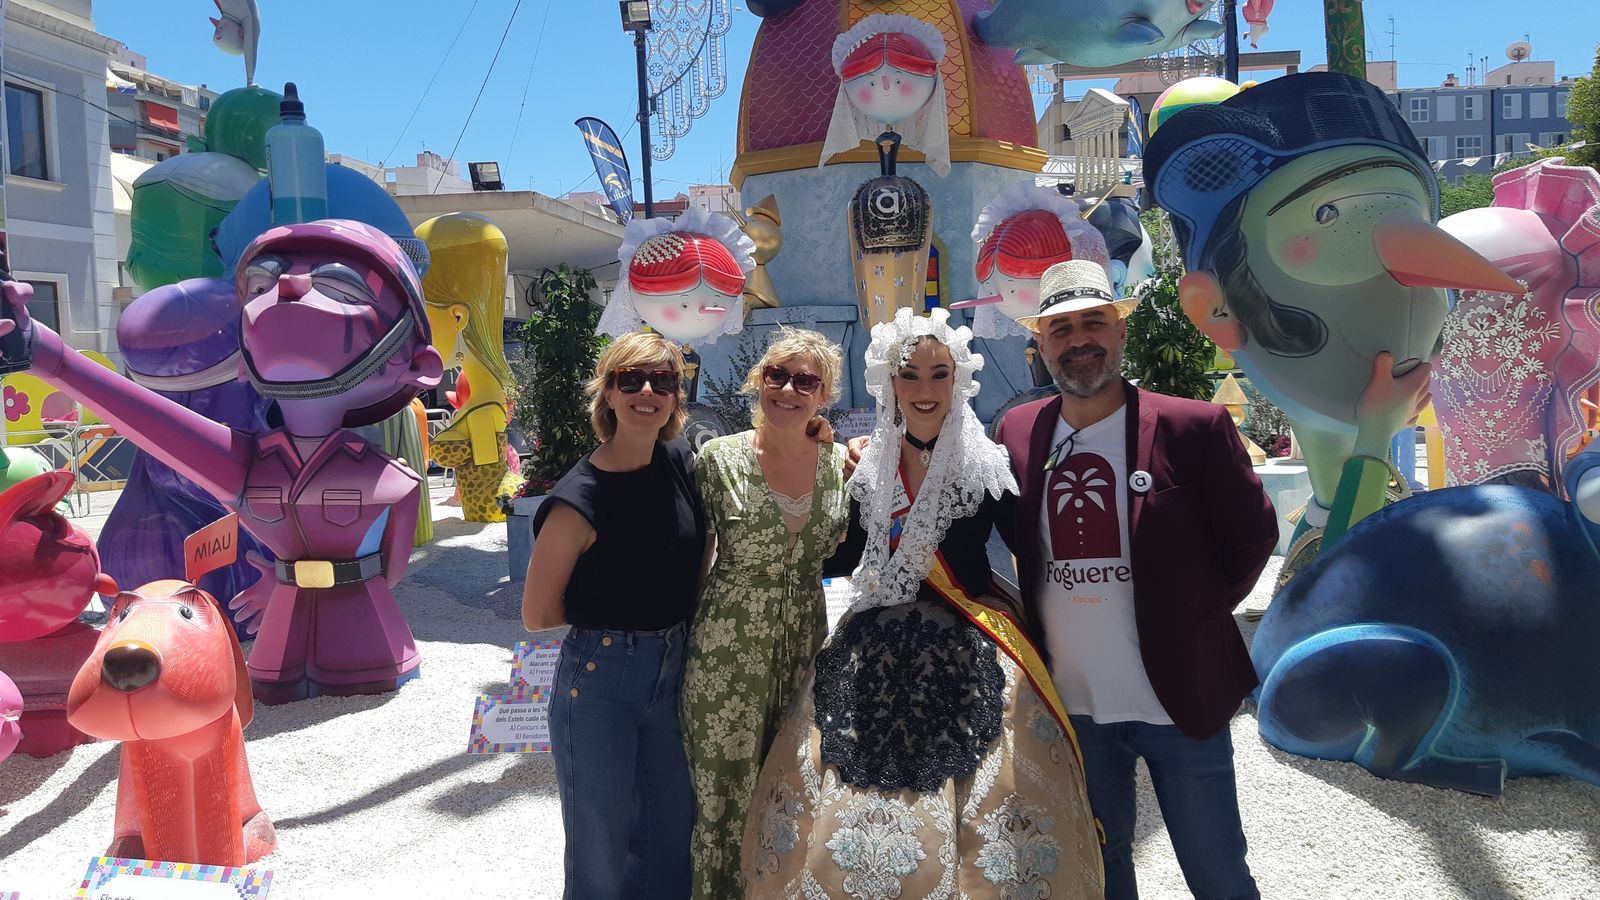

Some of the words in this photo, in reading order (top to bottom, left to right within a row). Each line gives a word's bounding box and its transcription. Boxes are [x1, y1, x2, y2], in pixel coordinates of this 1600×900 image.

[1135, 474, 1148, 487] à
[194, 532, 231, 563] MIAU
[1046, 561, 1134, 591] Foguere
